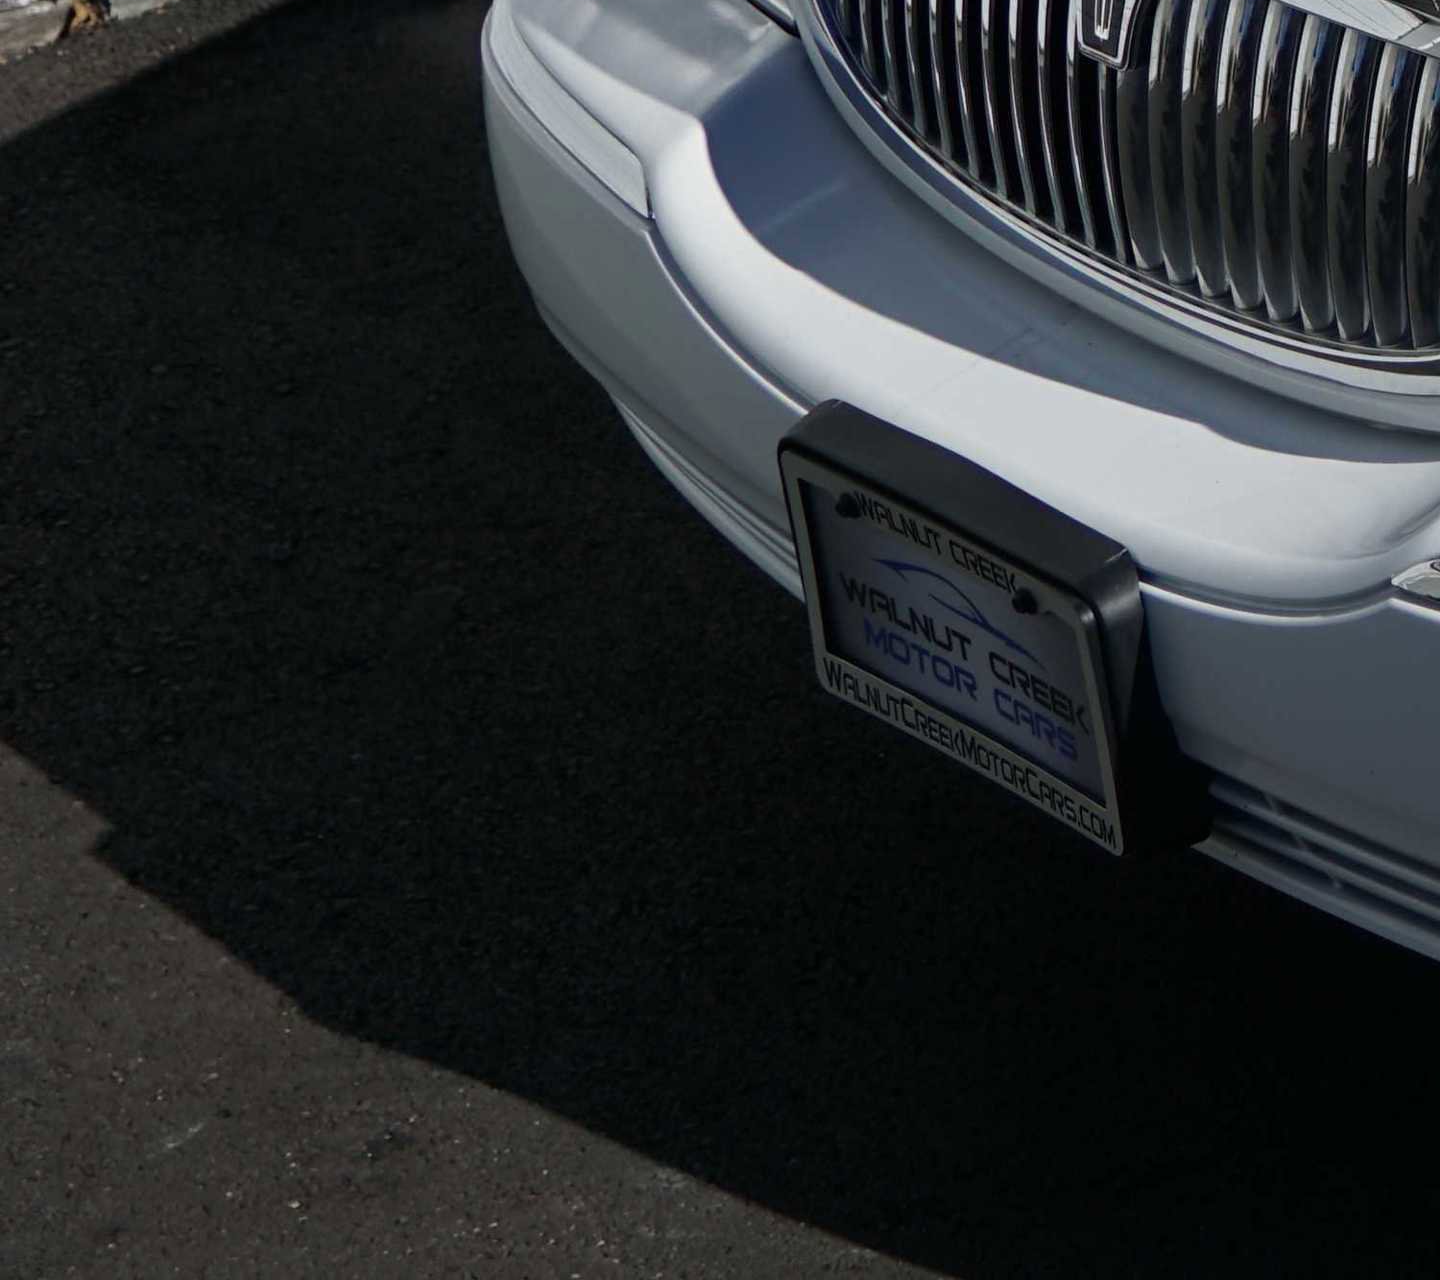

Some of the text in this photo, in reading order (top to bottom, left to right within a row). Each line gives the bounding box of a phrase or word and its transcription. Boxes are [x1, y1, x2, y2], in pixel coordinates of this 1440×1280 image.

[855, 490, 1016, 593] WALNUT CREEK
[839, 571, 1090, 736] WALNUT CREEK
[863, 616, 1079, 763] MOTOR CARS
